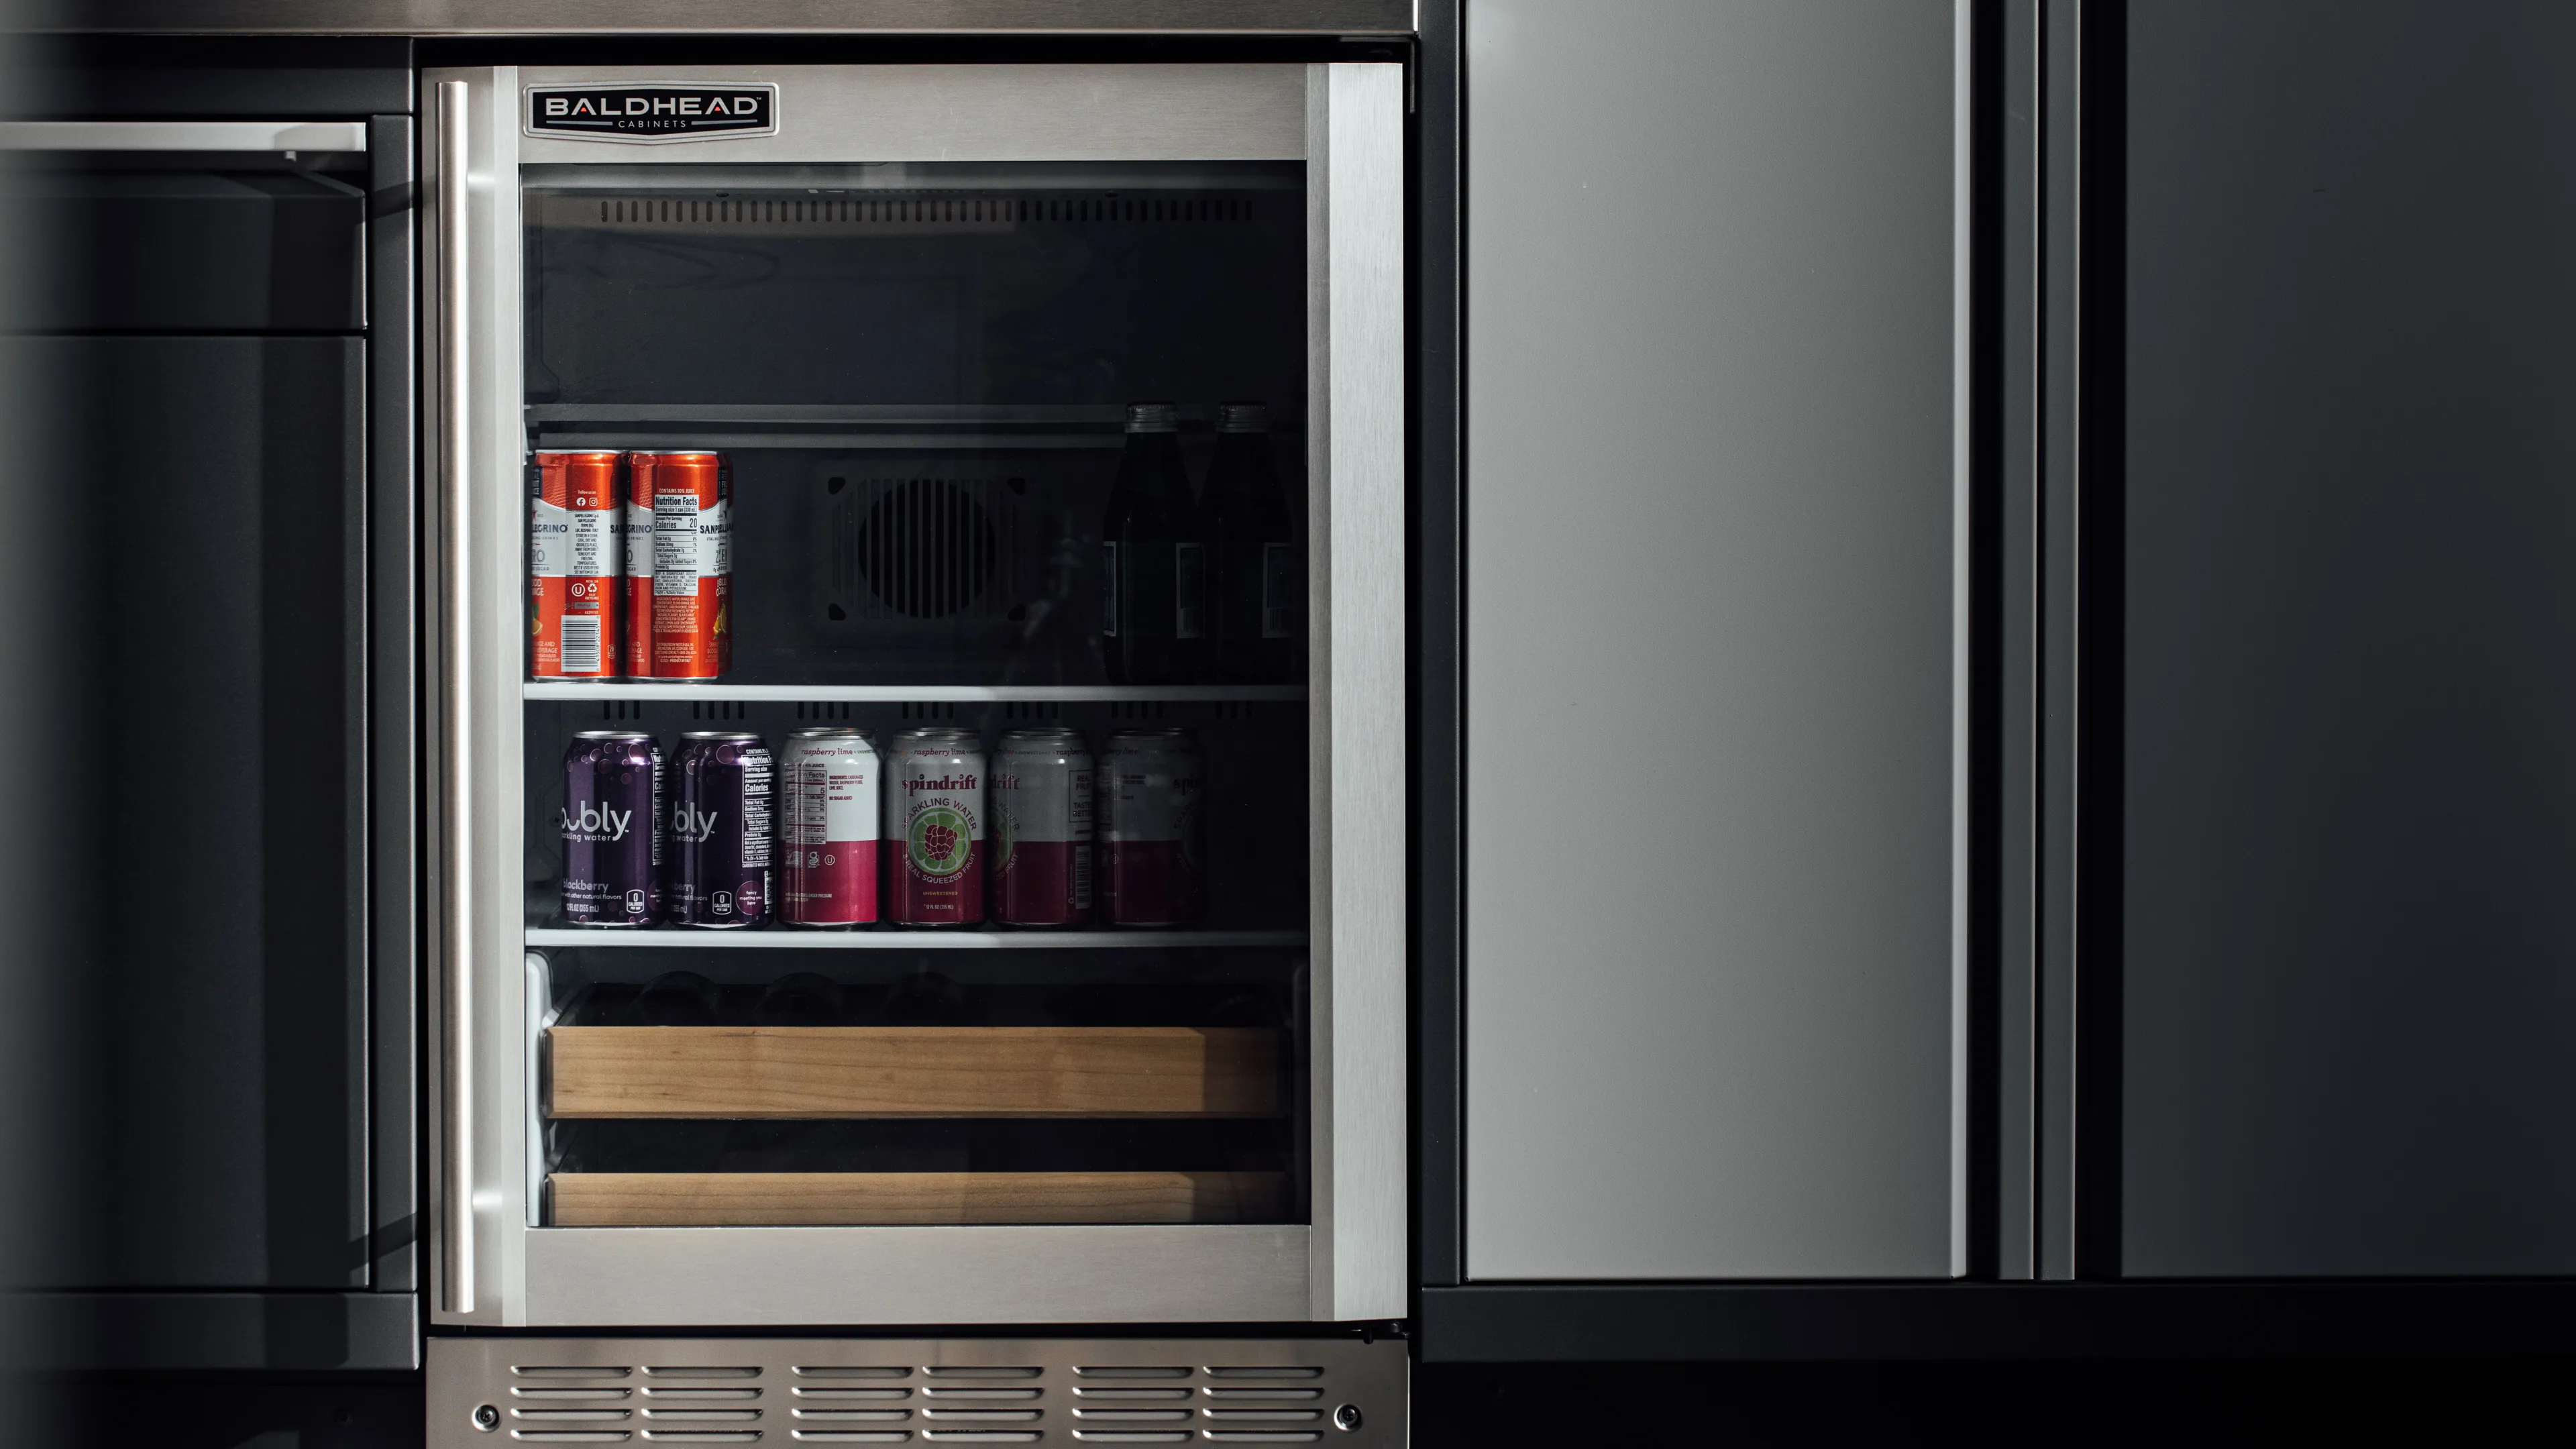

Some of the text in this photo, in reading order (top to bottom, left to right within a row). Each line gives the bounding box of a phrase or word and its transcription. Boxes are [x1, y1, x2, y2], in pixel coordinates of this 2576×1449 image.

[546, 97, 757, 115] BALDHEAD
[655, 496, 697, 506] Nutrition Facts
[690, 518, 697, 528] 20
[801, 748, 836, 756] raspberry
[914, 748, 950, 756] raspberry
[1057, 747, 1085, 756] raspberry
[744, 756, 768, 764] Nutrition
[745, 784, 769, 792] Calories
[901, 773, 977, 797] spindrift
[902, 798, 977, 830] SPARKLING WATER
[906, 852, 975, 884] REAL SQUEEZED FRUIT
[564, 877, 609, 894] blackberry
[633, 893, 638, 902] 0
[720, 895, 724, 904] 0
